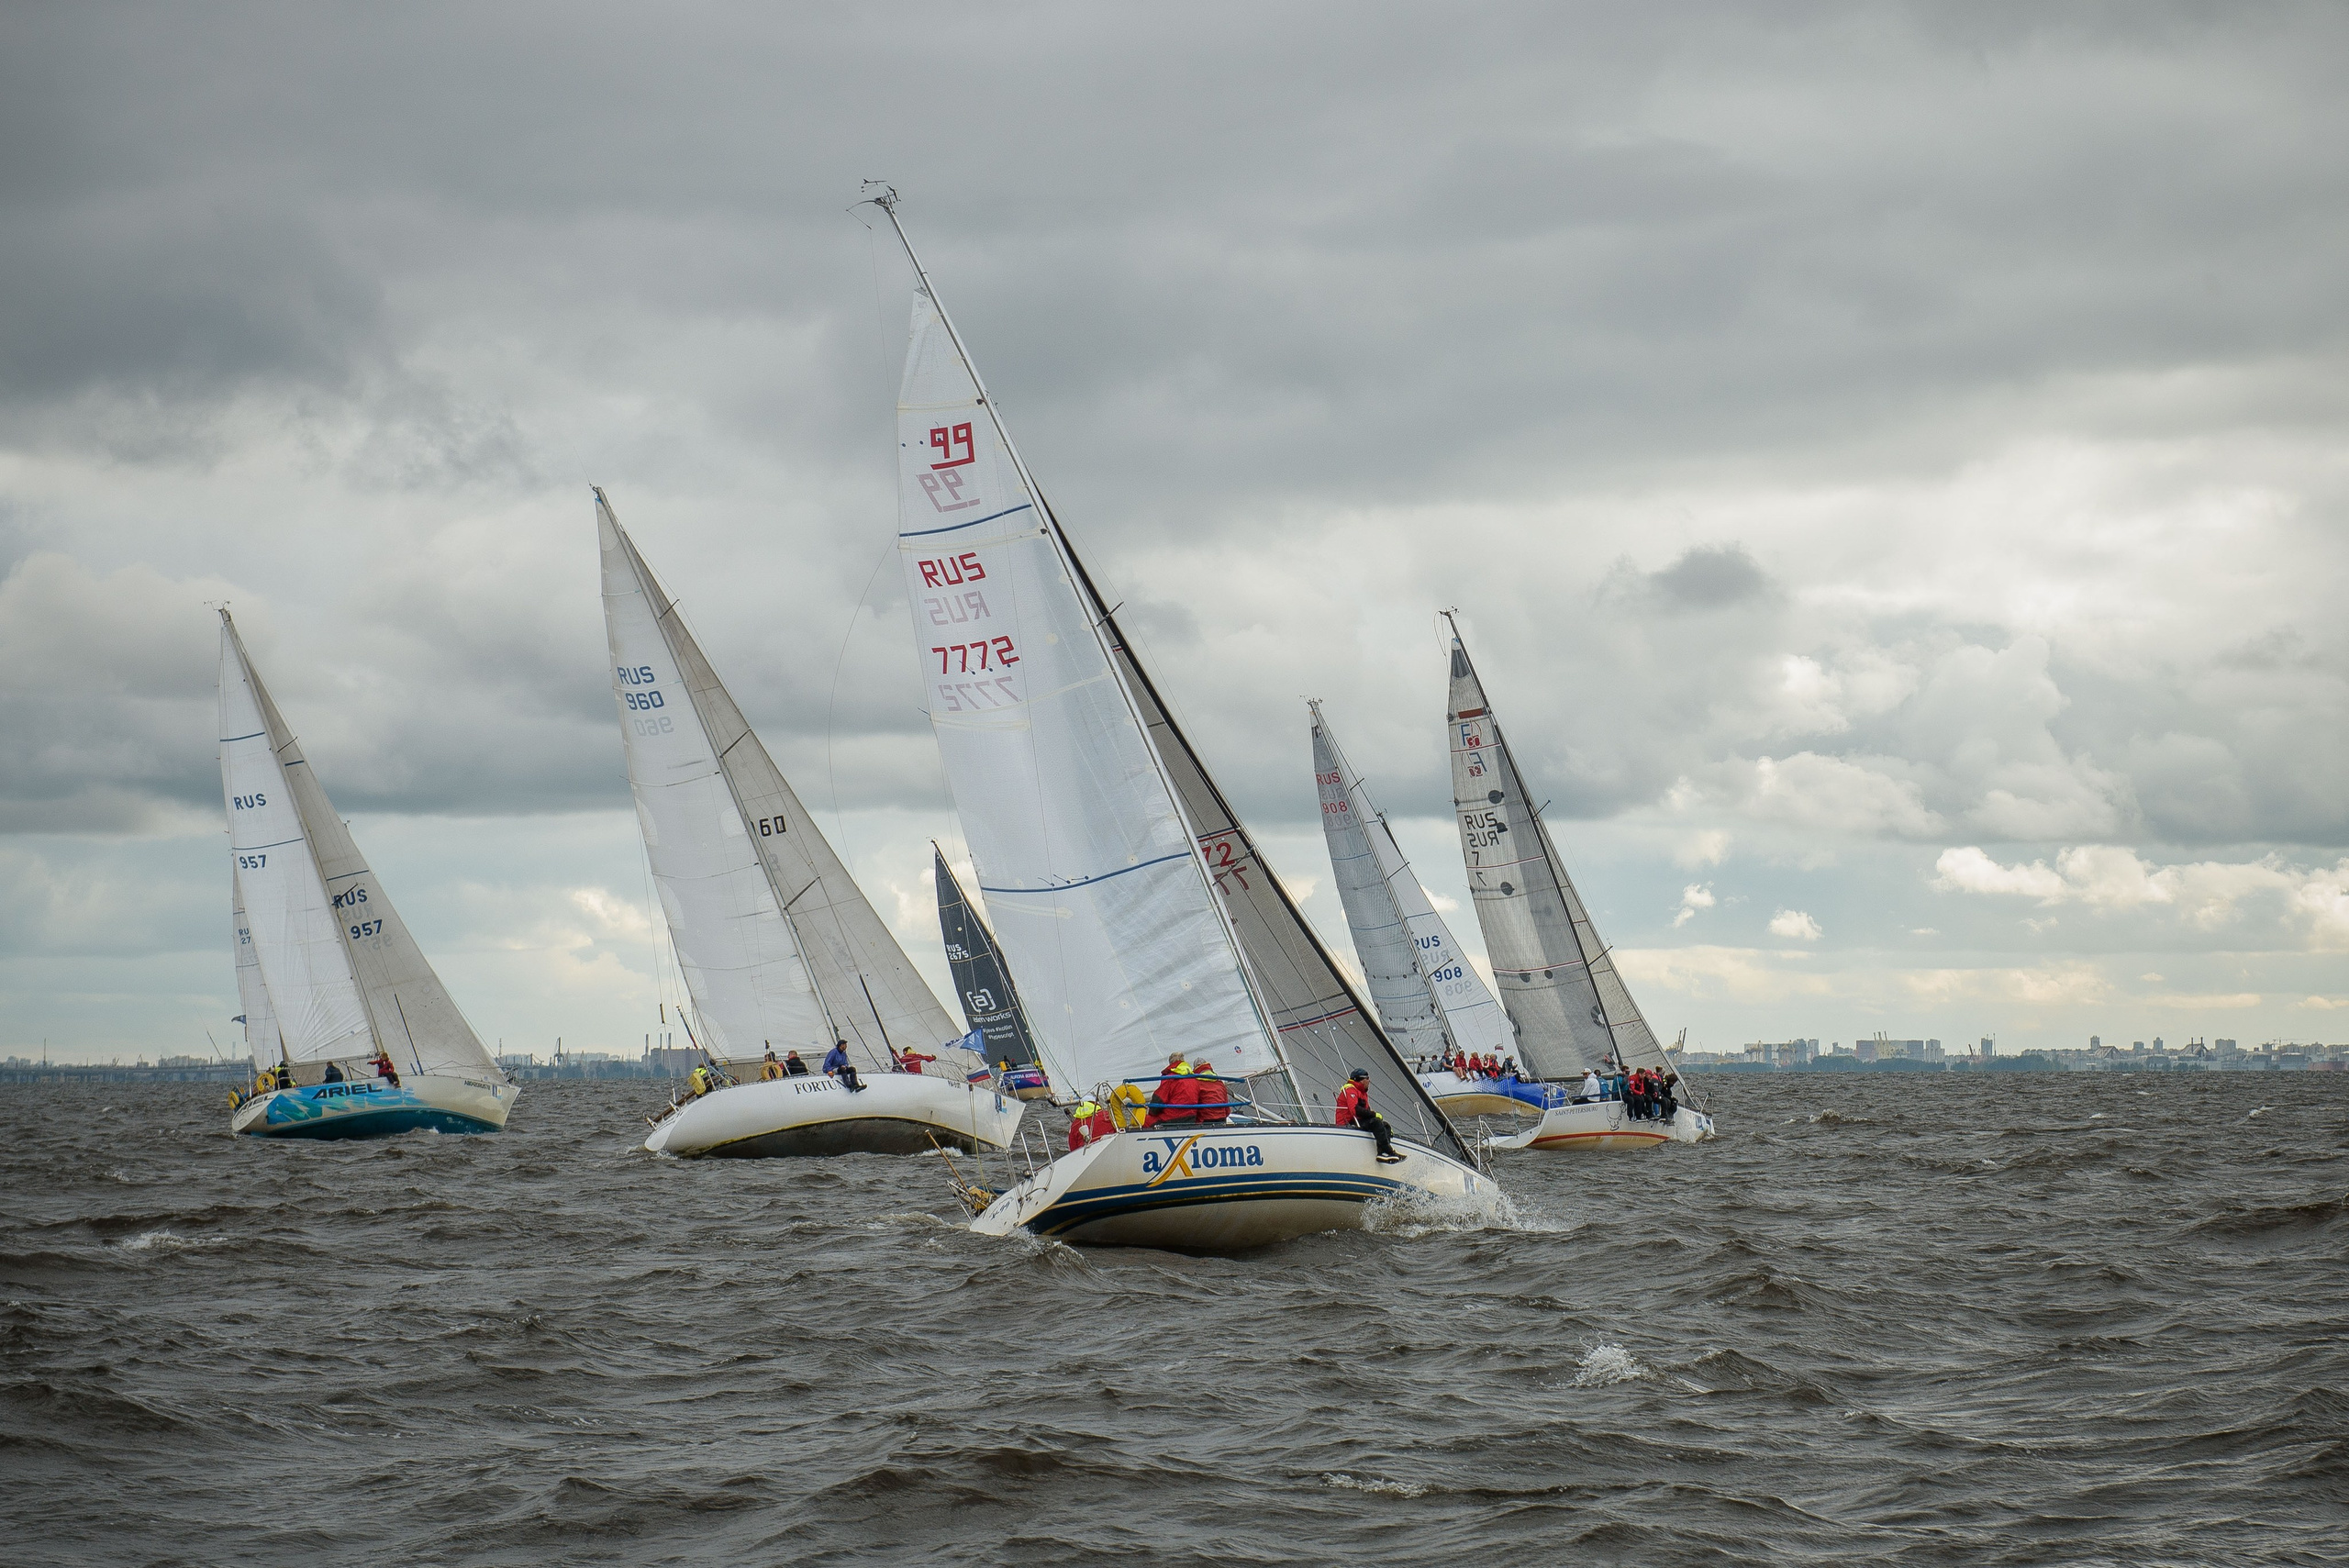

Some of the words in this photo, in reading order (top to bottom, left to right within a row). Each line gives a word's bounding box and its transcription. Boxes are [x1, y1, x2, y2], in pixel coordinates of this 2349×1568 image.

[918, 552, 986, 588] RUS
[931, 635, 1020, 675] 7772
[618, 665, 655, 685] RUS
[625, 690, 664, 711] 960
[1316, 772, 1341, 785] RUS
[233, 793, 267, 810] RUS
[1322, 800, 1348, 815] 908
[750, 815, 787, 838] 60
[1464, 811, 1498, 830] RUS
[239, 853, 267, 870] 957
[332, 888, 368, 909] RUS
[350, 918, 383, 940] 957
[946, 943, 962, 952] RUS
[948, 950, 969, 961] 2675
[1433, 966, 1463, 983] 908
[985, 1011, 1012, 1023] works
[312, 1083, 383, 1100] ARIEL
[794, 1078, 863, 1095] FORTUN
[1554, 1106, 1598, 1117] SAINT-PETERSBURG
